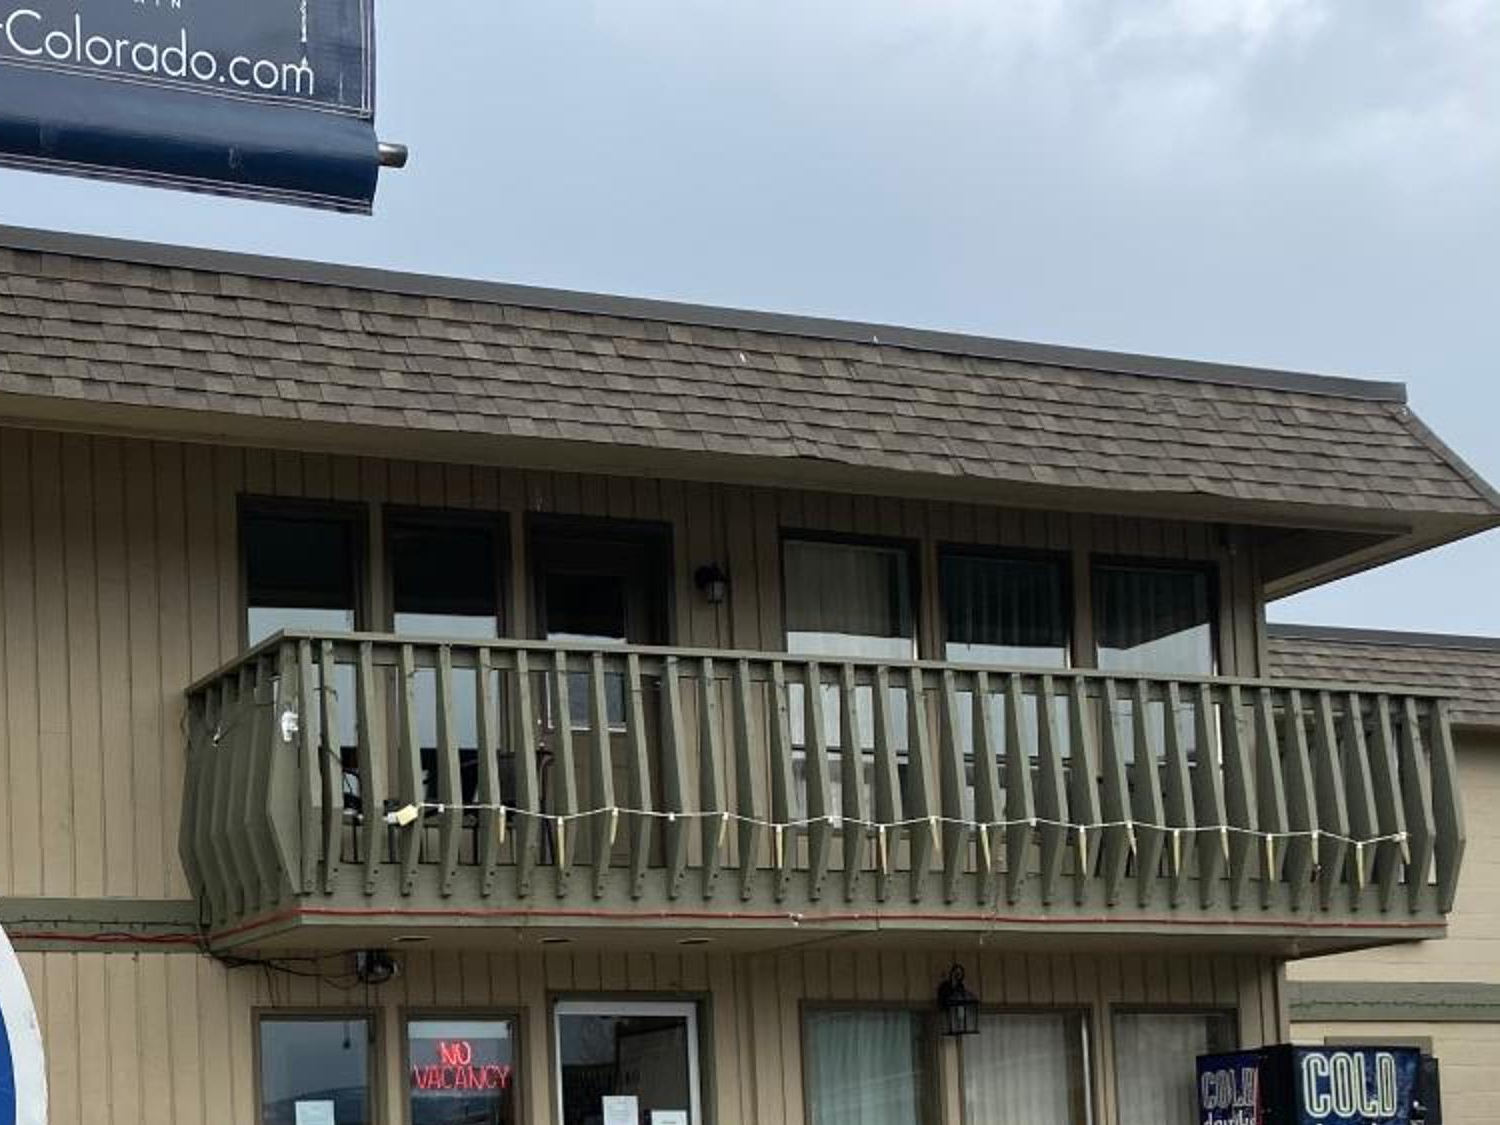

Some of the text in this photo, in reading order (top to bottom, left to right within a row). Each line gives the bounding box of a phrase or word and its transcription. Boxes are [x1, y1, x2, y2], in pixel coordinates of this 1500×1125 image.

[440, 1040, 472, 1065] NO
[413, 1064, 511, 1090] VACANCY
[1304, 1053, 1398, 1118] COLD
